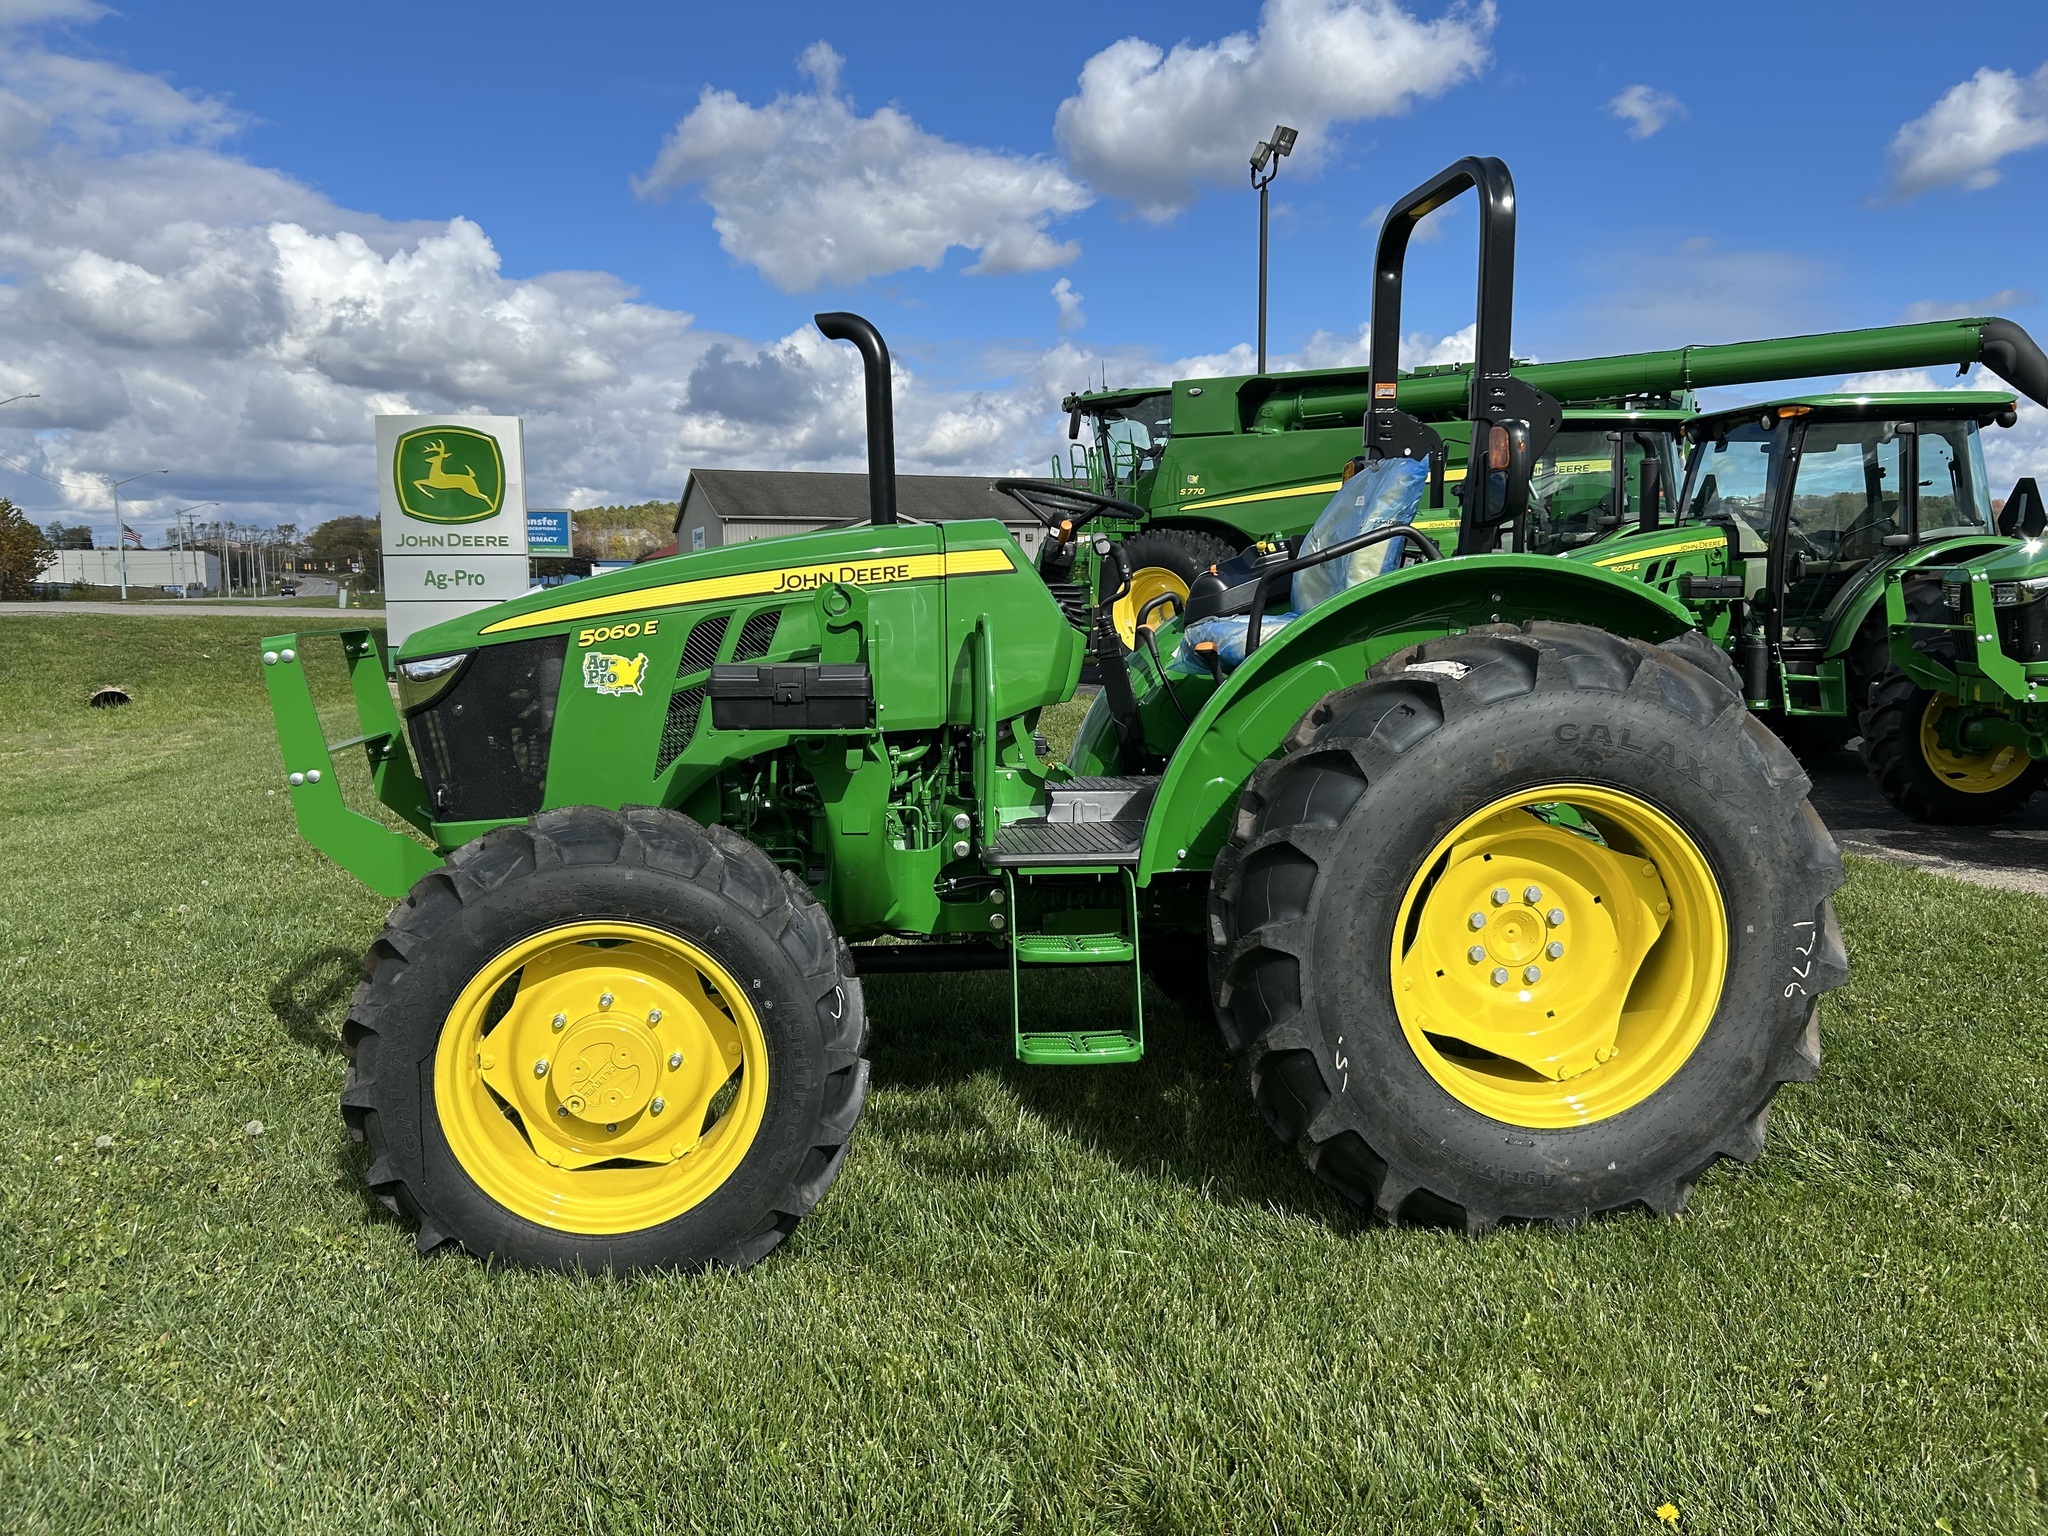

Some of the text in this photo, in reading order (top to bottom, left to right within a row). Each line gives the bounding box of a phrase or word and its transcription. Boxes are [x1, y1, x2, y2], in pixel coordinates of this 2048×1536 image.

[527, 516, 558, 526] nsfer
[395, 533, 509, 548] JOHN DEERE
[1699, 540, 1722, 549] DEERE
[424, 570, 485, 589] Ag-Pro
[774, 565, 909, 591] JOHN DEERE
[578, 623, 641, 648] 5060
[587, 670, 618, 685] Pro
[1552, 722, 1740, 803] GALAXY
